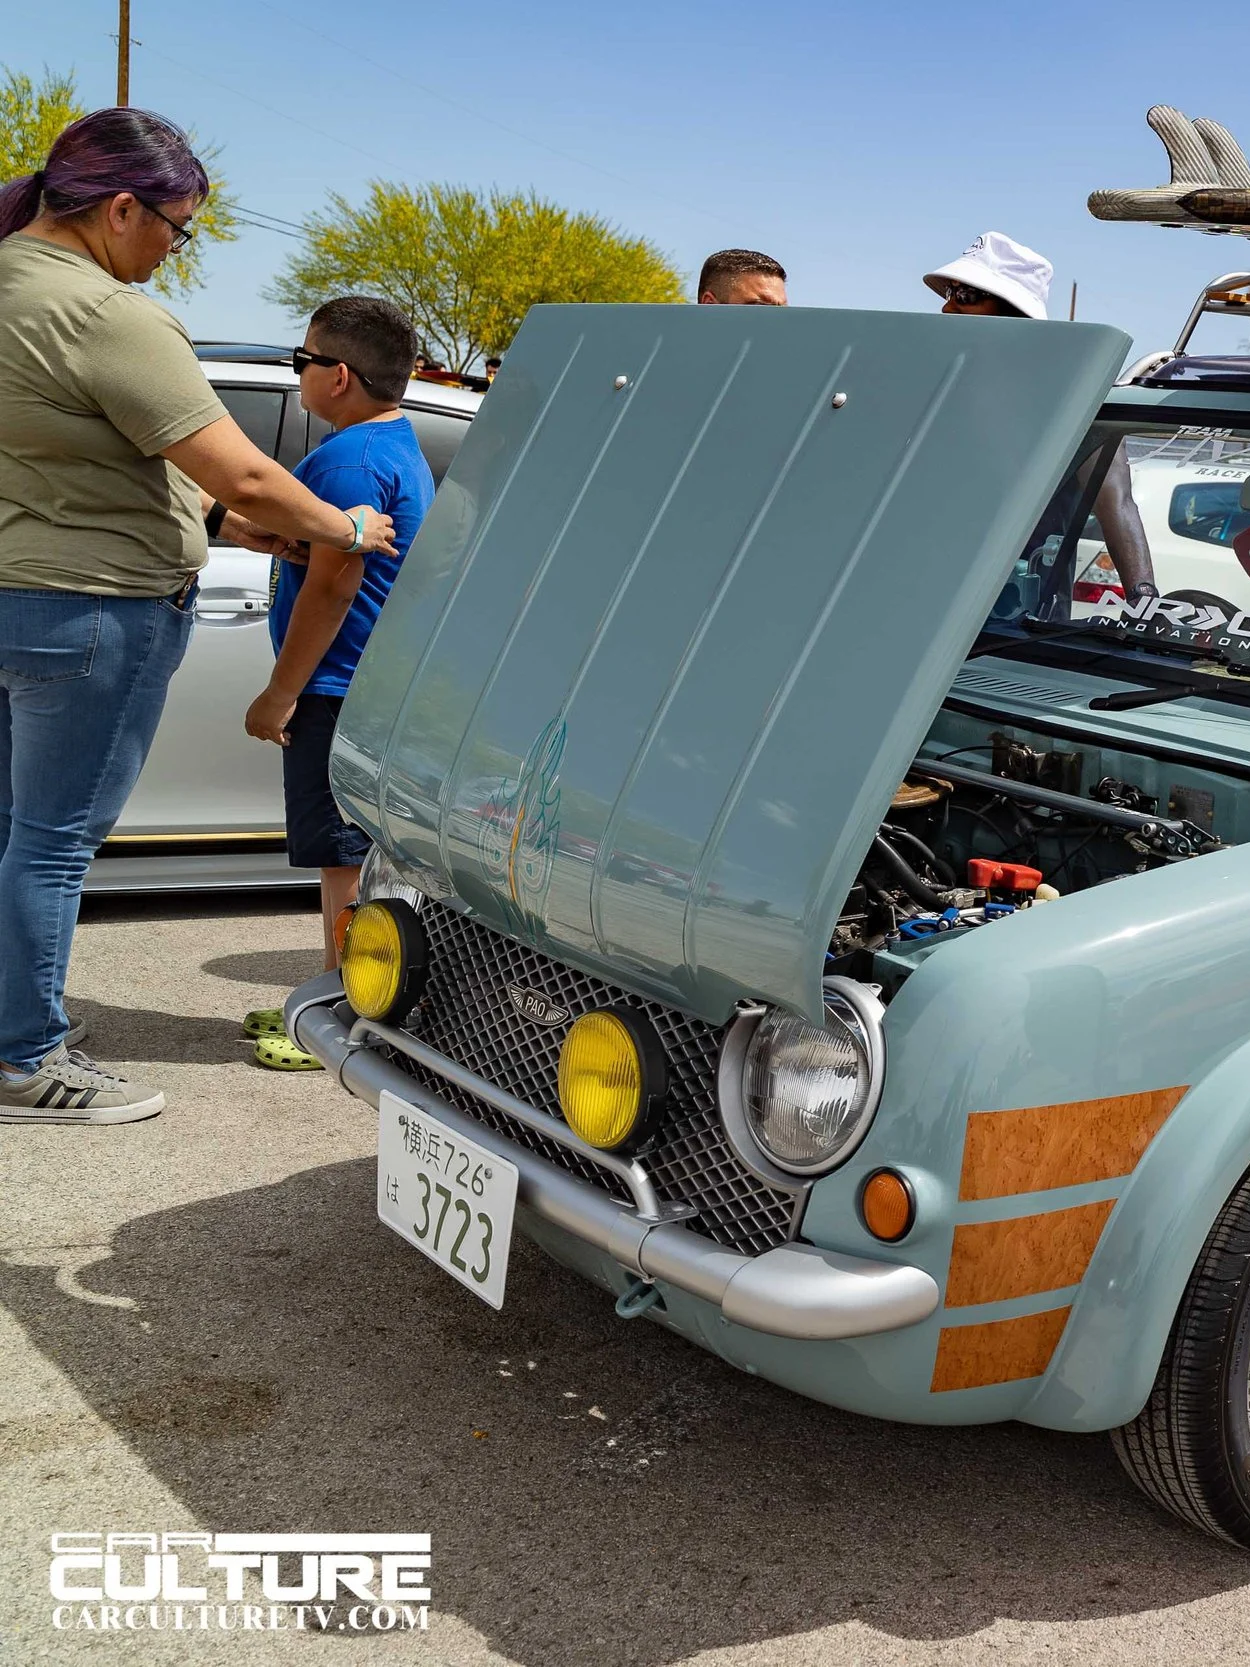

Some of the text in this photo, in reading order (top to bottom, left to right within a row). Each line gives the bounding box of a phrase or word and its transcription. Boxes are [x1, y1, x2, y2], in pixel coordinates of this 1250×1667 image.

[1177, 425, 1233, 438] TEAM
[1195, 467, 1245, 479] RACE
[525, 996, 546, 1017] PAO
[386, 1172, 493, 1284] は 3723
